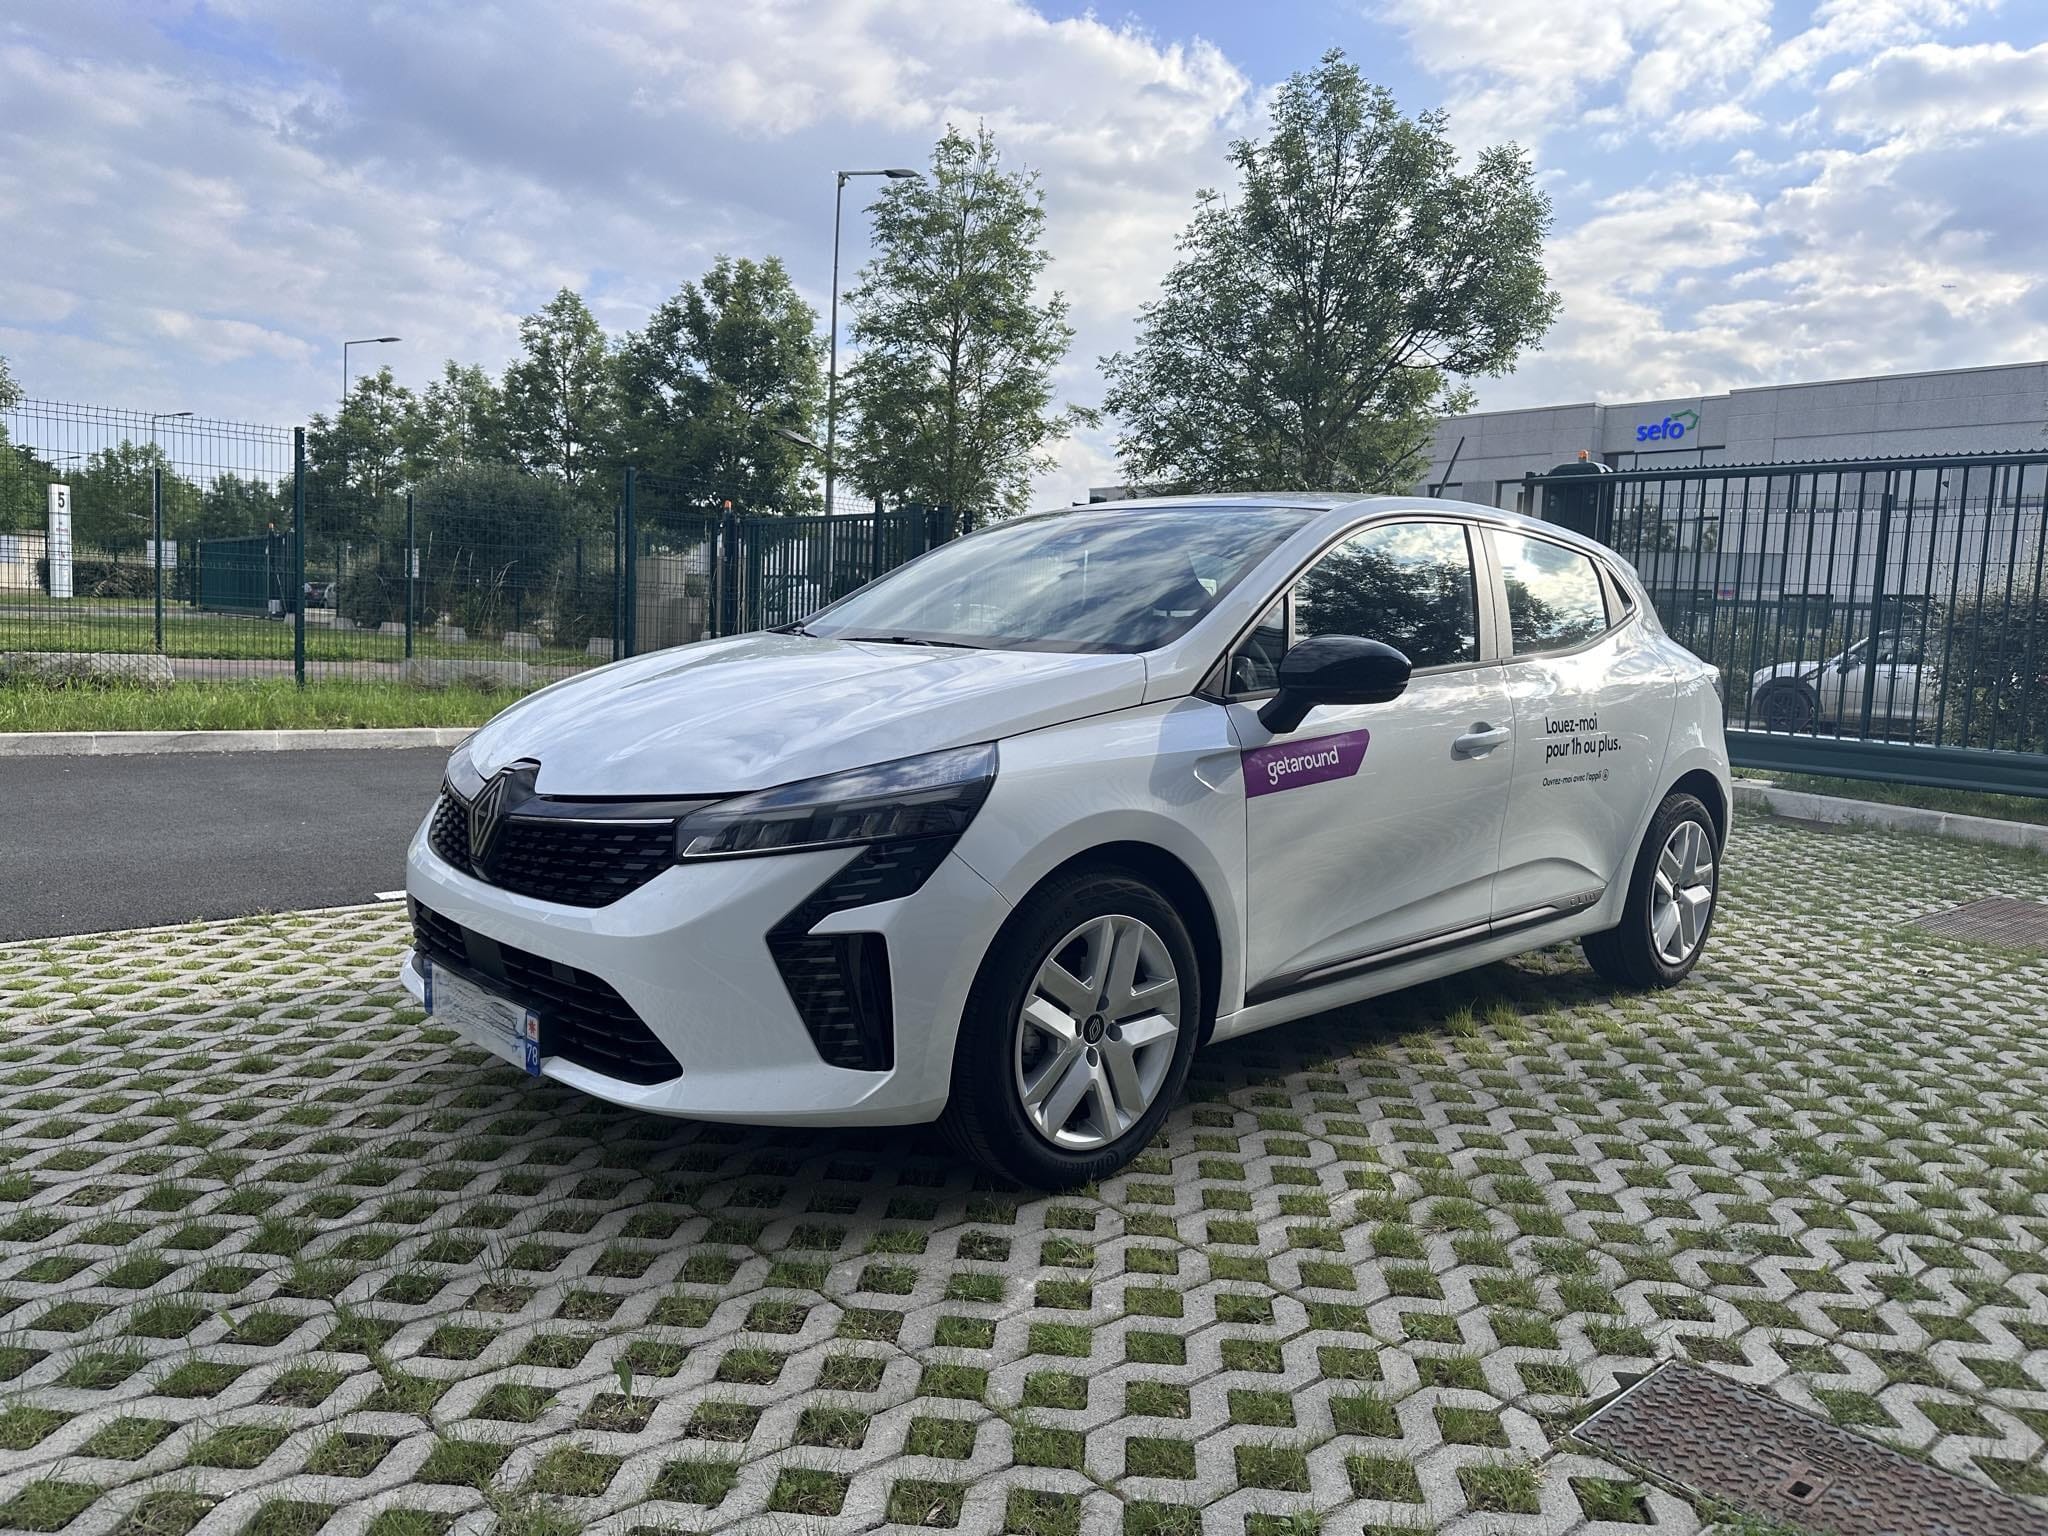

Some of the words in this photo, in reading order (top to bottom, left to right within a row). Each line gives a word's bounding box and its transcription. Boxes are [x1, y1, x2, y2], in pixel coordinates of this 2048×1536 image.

[1636, 416, 1684, 441] sefo
[58, 492, 64, 508] 5
[1545, 712, 1598, 734] Louez-moi
[1545, 743, 1569, 763] pour
[1571, 737, 1582, 755] 1h
[1584, 741, 1596, 754] ou
[1598, 735, 1621, 757] plus.
[1267, 745, 1339, 785] getaround
[1542, 775, 1572, 787] Ouvrez-moi
[1573, 774, 1586, 784] avec
[527, 1043, 538, 1066] 78
